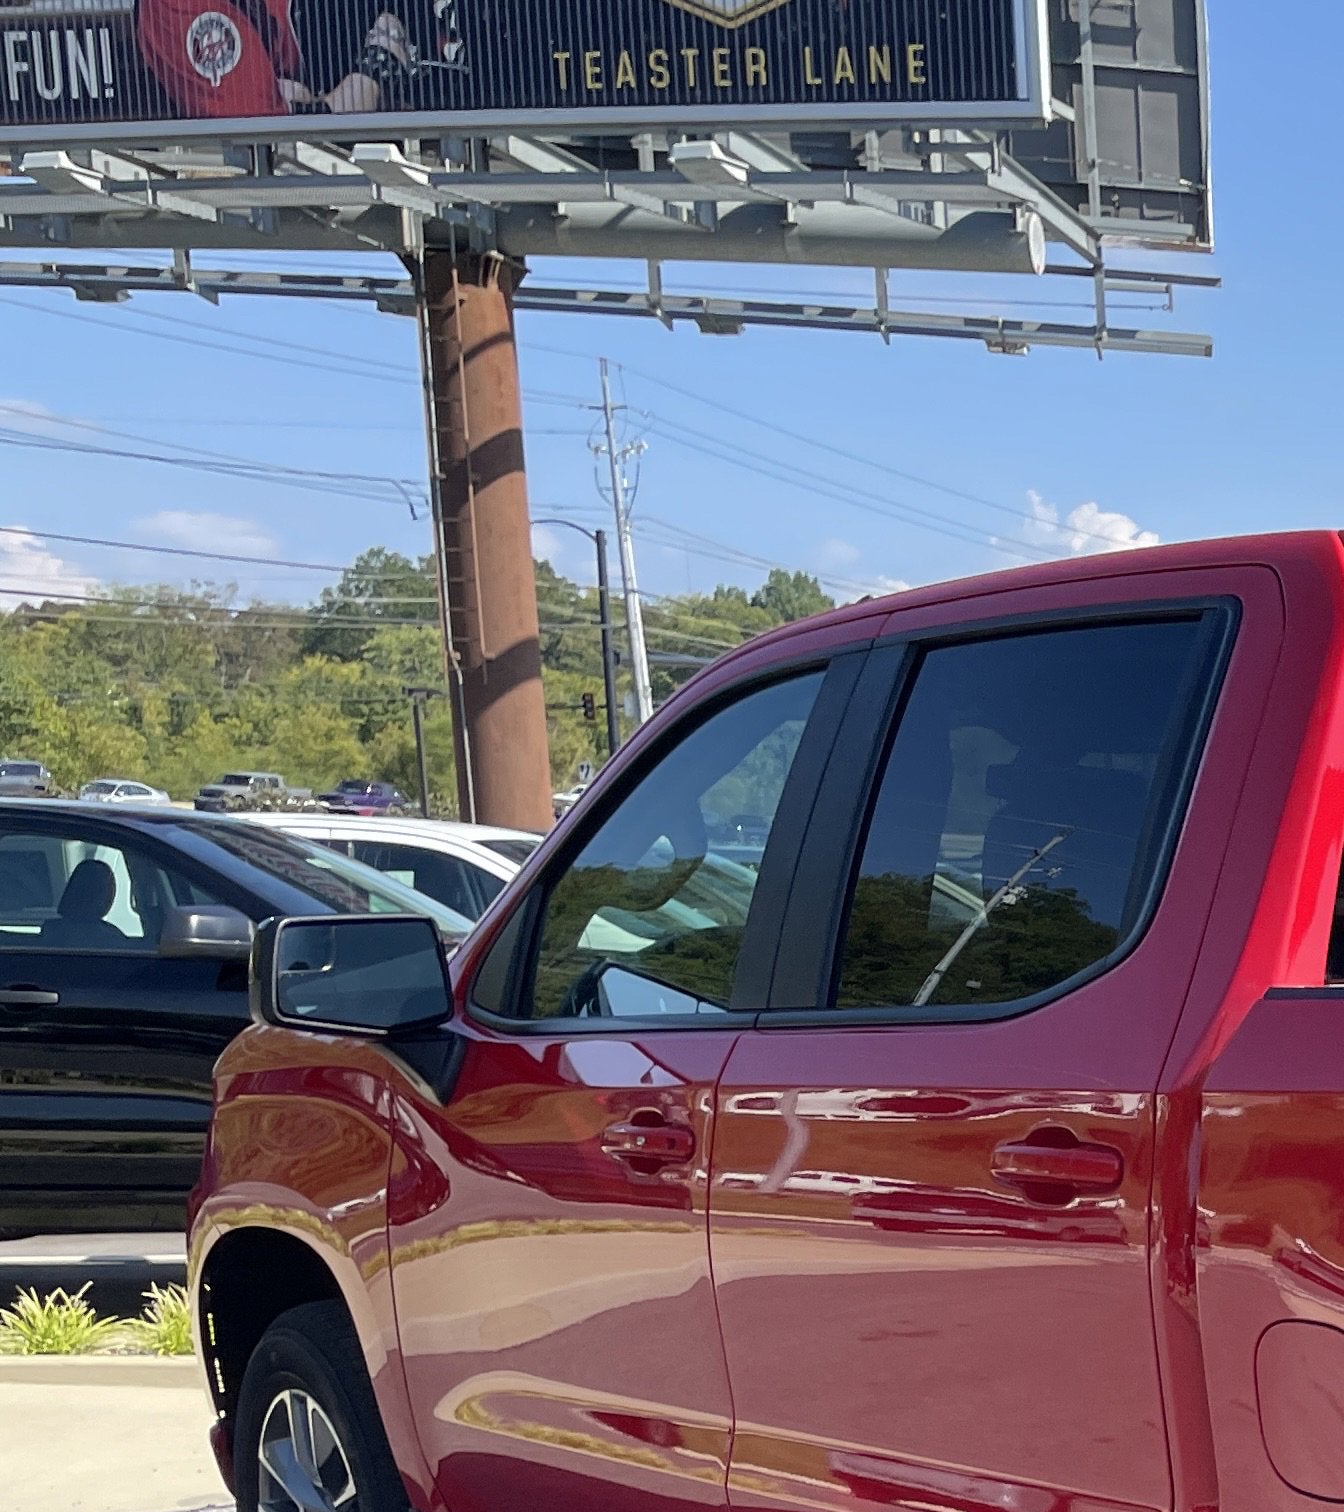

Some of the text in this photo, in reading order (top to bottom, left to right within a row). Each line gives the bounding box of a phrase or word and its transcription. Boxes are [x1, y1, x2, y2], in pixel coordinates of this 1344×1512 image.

[4, 27, 114, 100] FUN!
[553, 44, 926, 91] TEASTER LANE
